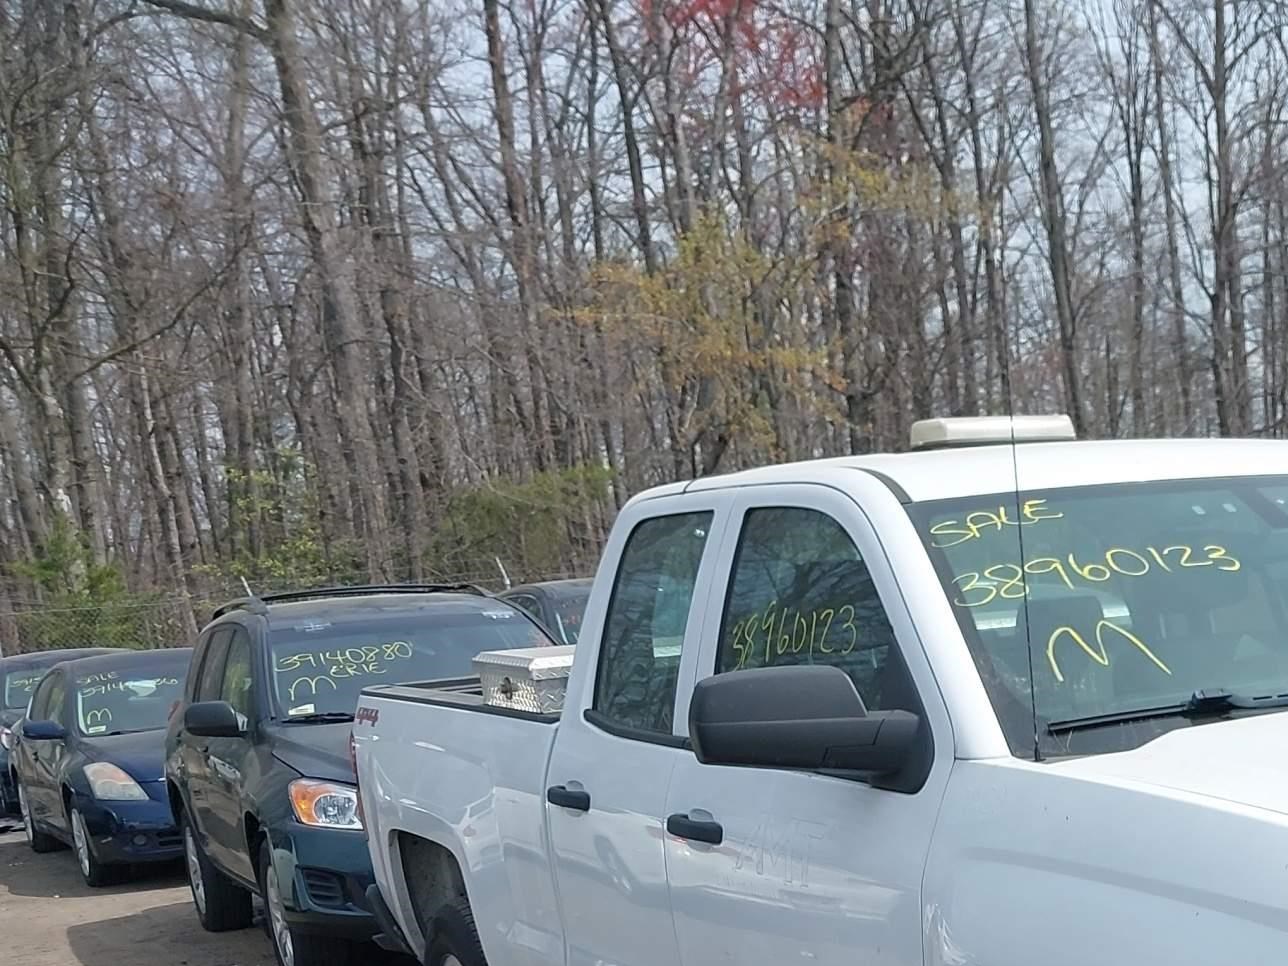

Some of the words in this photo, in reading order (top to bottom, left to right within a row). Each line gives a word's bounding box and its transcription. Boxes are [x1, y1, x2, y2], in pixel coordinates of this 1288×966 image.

[931, 498, 1064, 547] SALE
[951, 545, 1241, 607] 38960123
[275, 641, 413, 672] 39140880
[732, 600, 857, 672] 38960123
[1046, 619, 1173, 683] M
